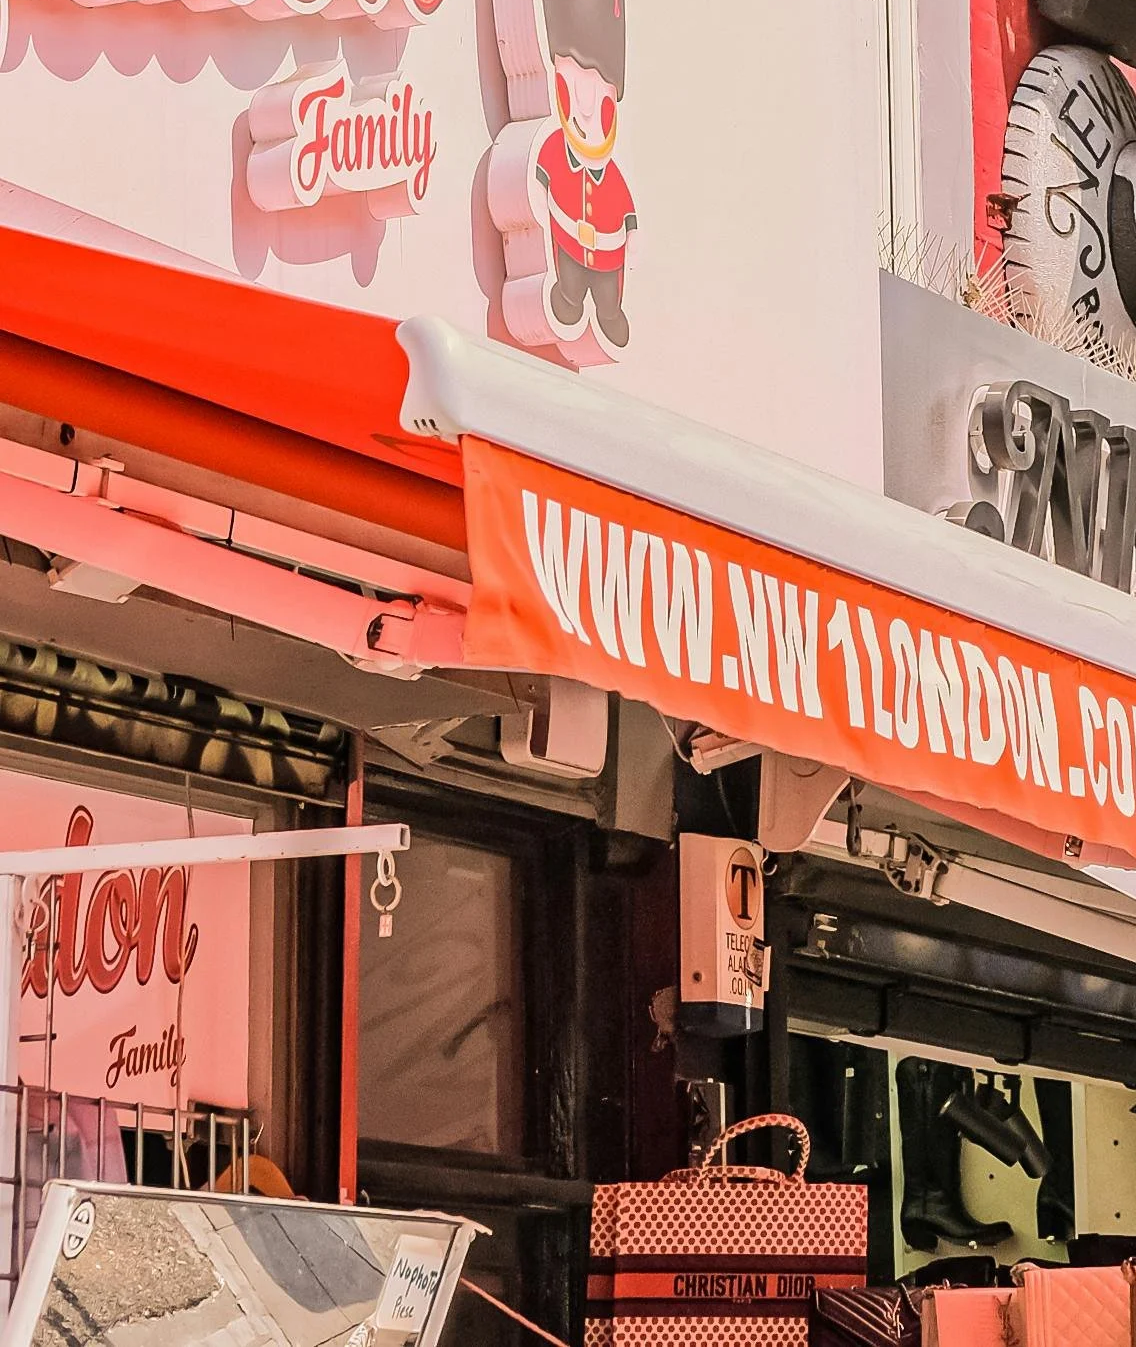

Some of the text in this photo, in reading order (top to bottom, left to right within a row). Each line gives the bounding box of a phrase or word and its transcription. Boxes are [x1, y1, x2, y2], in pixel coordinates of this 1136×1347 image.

[298, 75, 437, 201] Family
[731, 863, 756, 921] T
[106, 1024, 187, 1089] Family
[673, 1274, 816, 1298] CHRISTIAN DIOR
